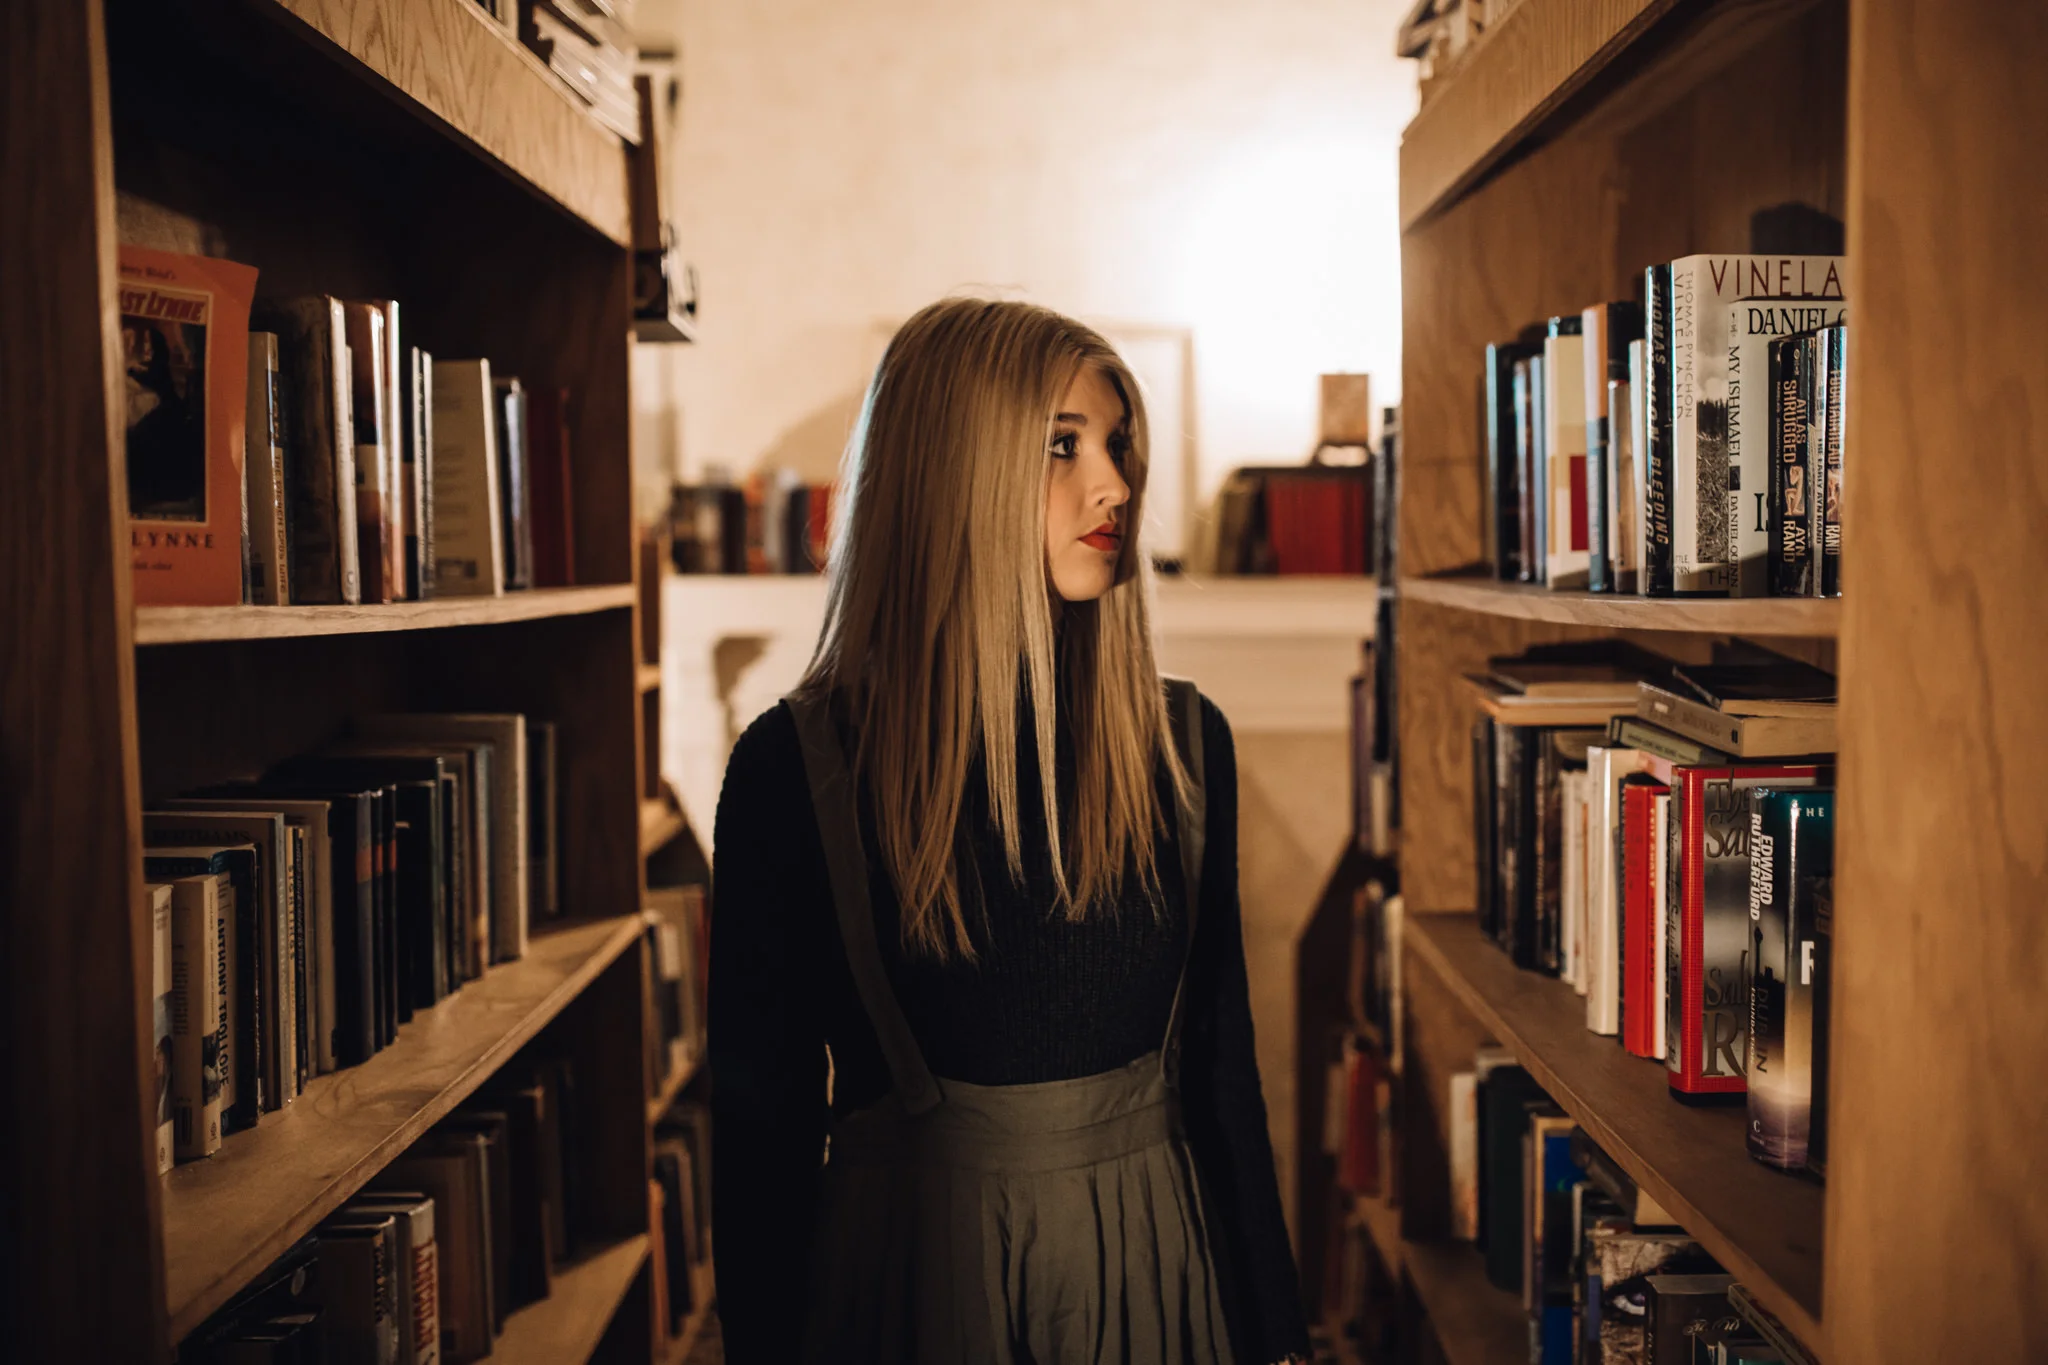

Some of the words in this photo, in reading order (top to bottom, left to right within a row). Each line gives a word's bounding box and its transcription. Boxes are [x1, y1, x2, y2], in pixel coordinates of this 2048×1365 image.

[1652, 282, 1667, 365] THOMAS
[1685, 271, 1694, 338] THOMAS
[1685, 343, 1694, 418] PYNCHON
[1728, 345, 1740, 373] MY
[1728, 380, 1741, 464] ISHMAEL
[1783, 380, 1797, 463] SHRUGGED
[1796, 398, 1807, 444] ATLAS
[1652, 457, 1669, 545] BLEEDING
[1729, 495, 1739, 543] DANIEL
[1729, 545, 1739, 588] QUINN
[1783, 520, 1796, 562] RAND
[1795, 526, 1806, 556] AYN
[1825, 524, 1841, 555] RAND
[1750, 813, 1762, 921] RUTHERFURD
[1760, 835, 1774, 906] EDWARD
